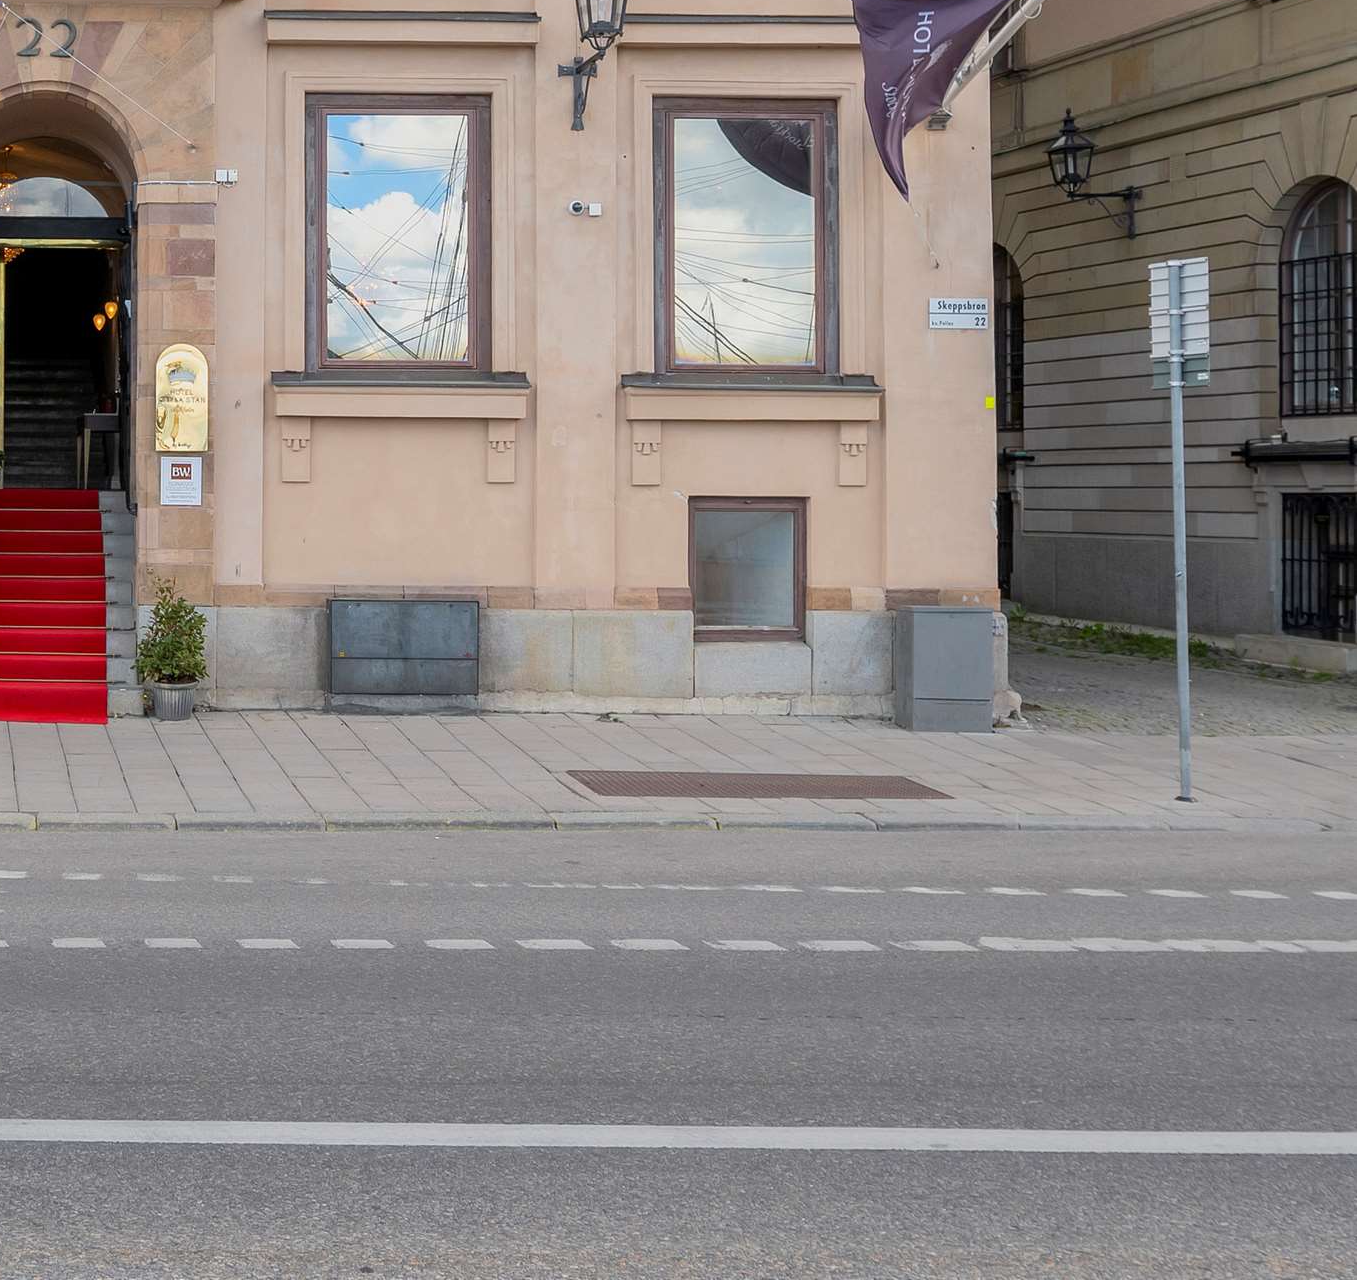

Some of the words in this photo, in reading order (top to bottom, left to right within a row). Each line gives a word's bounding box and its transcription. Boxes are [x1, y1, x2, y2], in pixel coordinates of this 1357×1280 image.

[16, 17, 77, 58] 22
[937, 300, 986, 313] Skeppsbron
[974, 316, 986, 326] 22
[172, 466, 191, 478] BW
